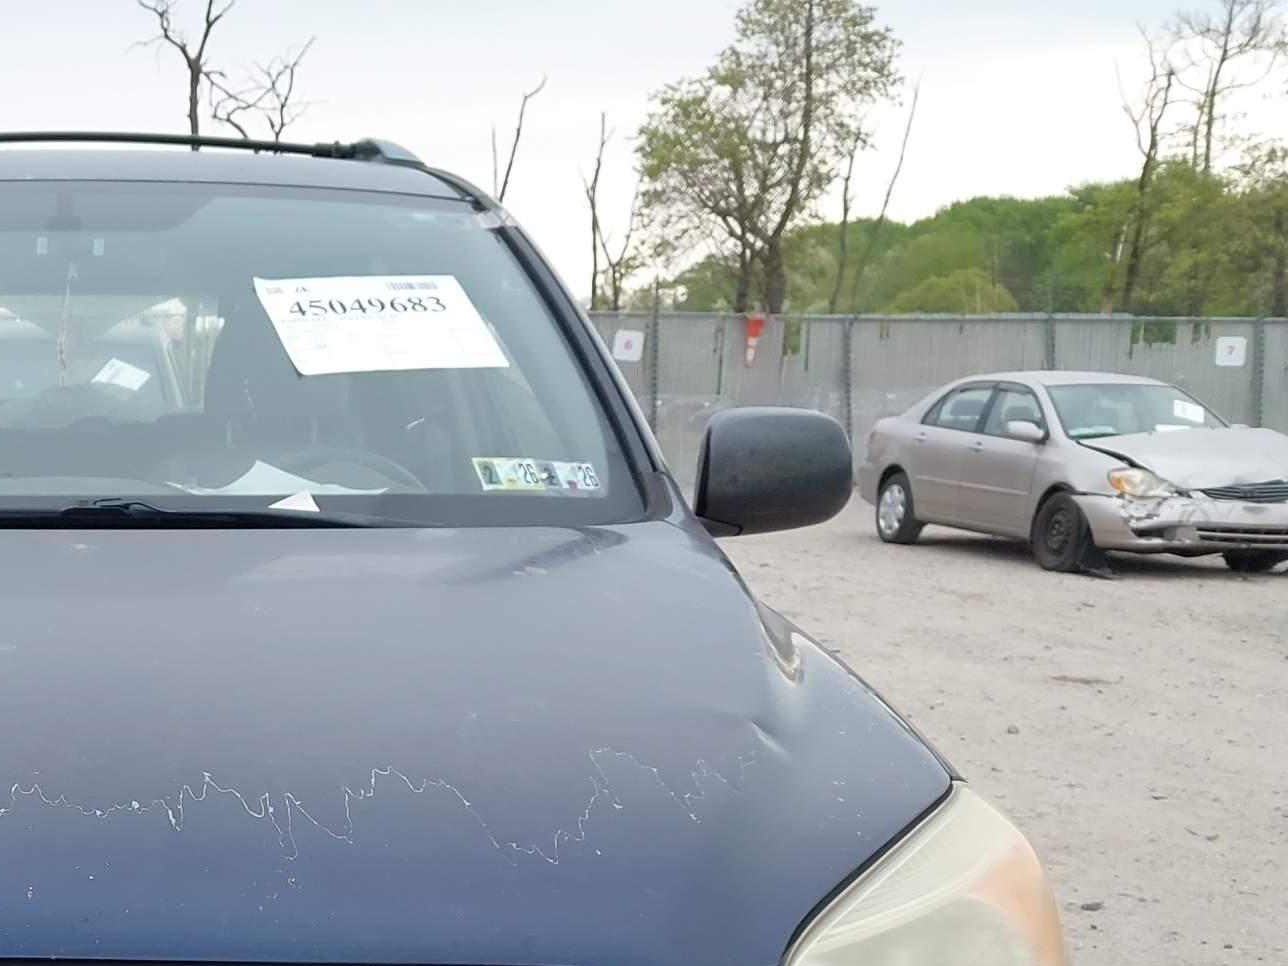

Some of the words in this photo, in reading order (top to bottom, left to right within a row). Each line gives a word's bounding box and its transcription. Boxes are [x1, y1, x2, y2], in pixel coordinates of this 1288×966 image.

[289, 297, 447, 317] 45049683
[518, 463, 540, 484] 26
[578, 465, 600, 487] 26
